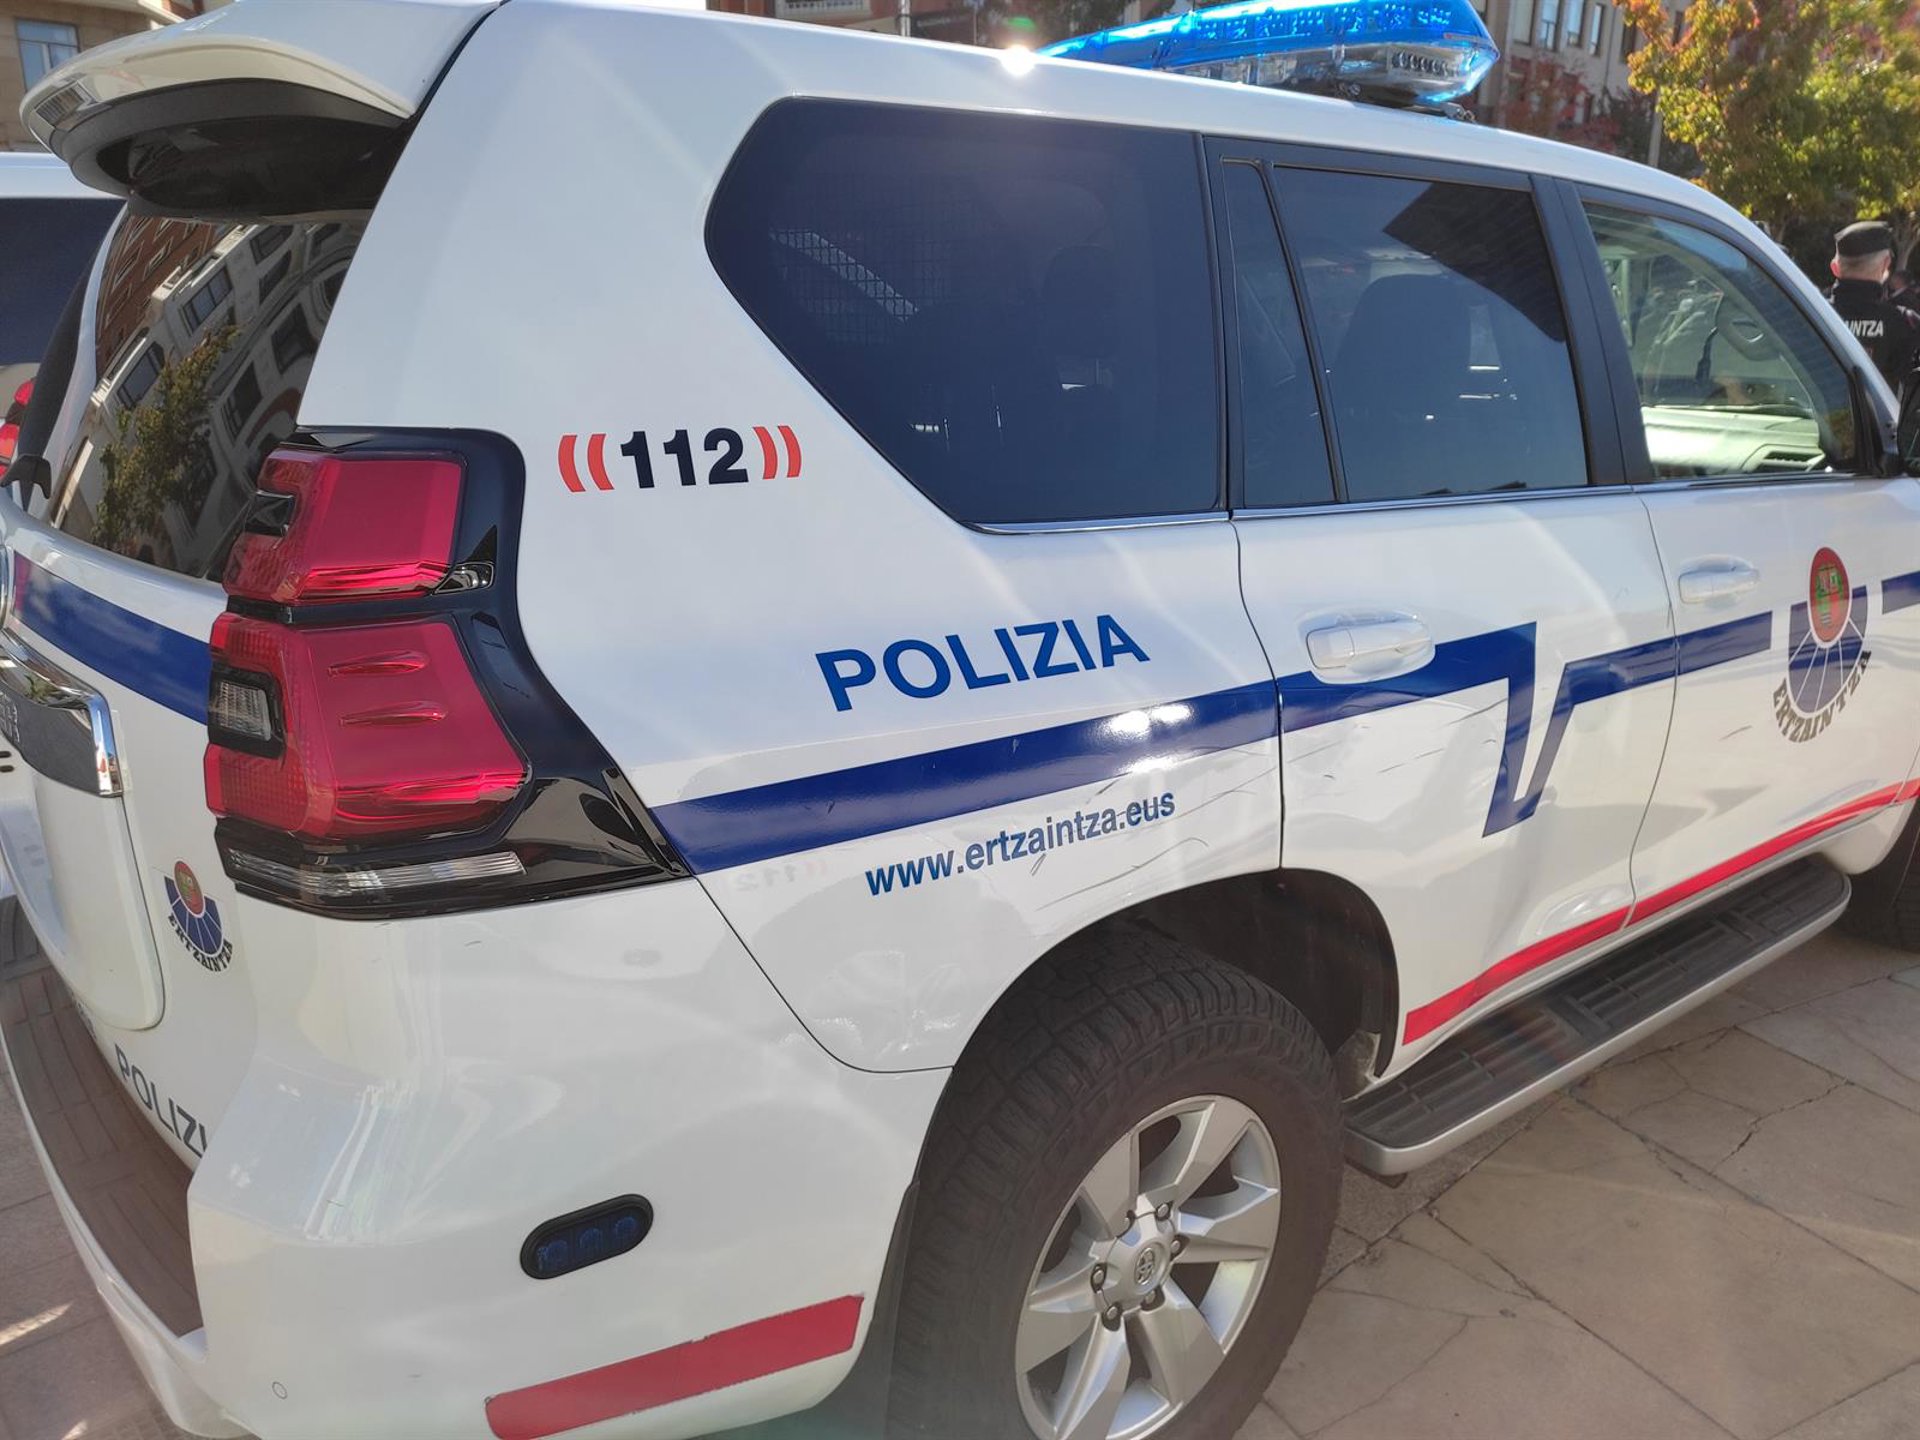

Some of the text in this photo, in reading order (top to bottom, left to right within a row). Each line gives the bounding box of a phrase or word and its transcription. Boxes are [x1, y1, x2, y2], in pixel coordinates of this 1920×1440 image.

[815, 614, 1150, 712] POLIZIA
[1773, 650, 1872, 743] ERTZAINTZA
[865, 792, 1175, 896] www.ertzaintza.eus
